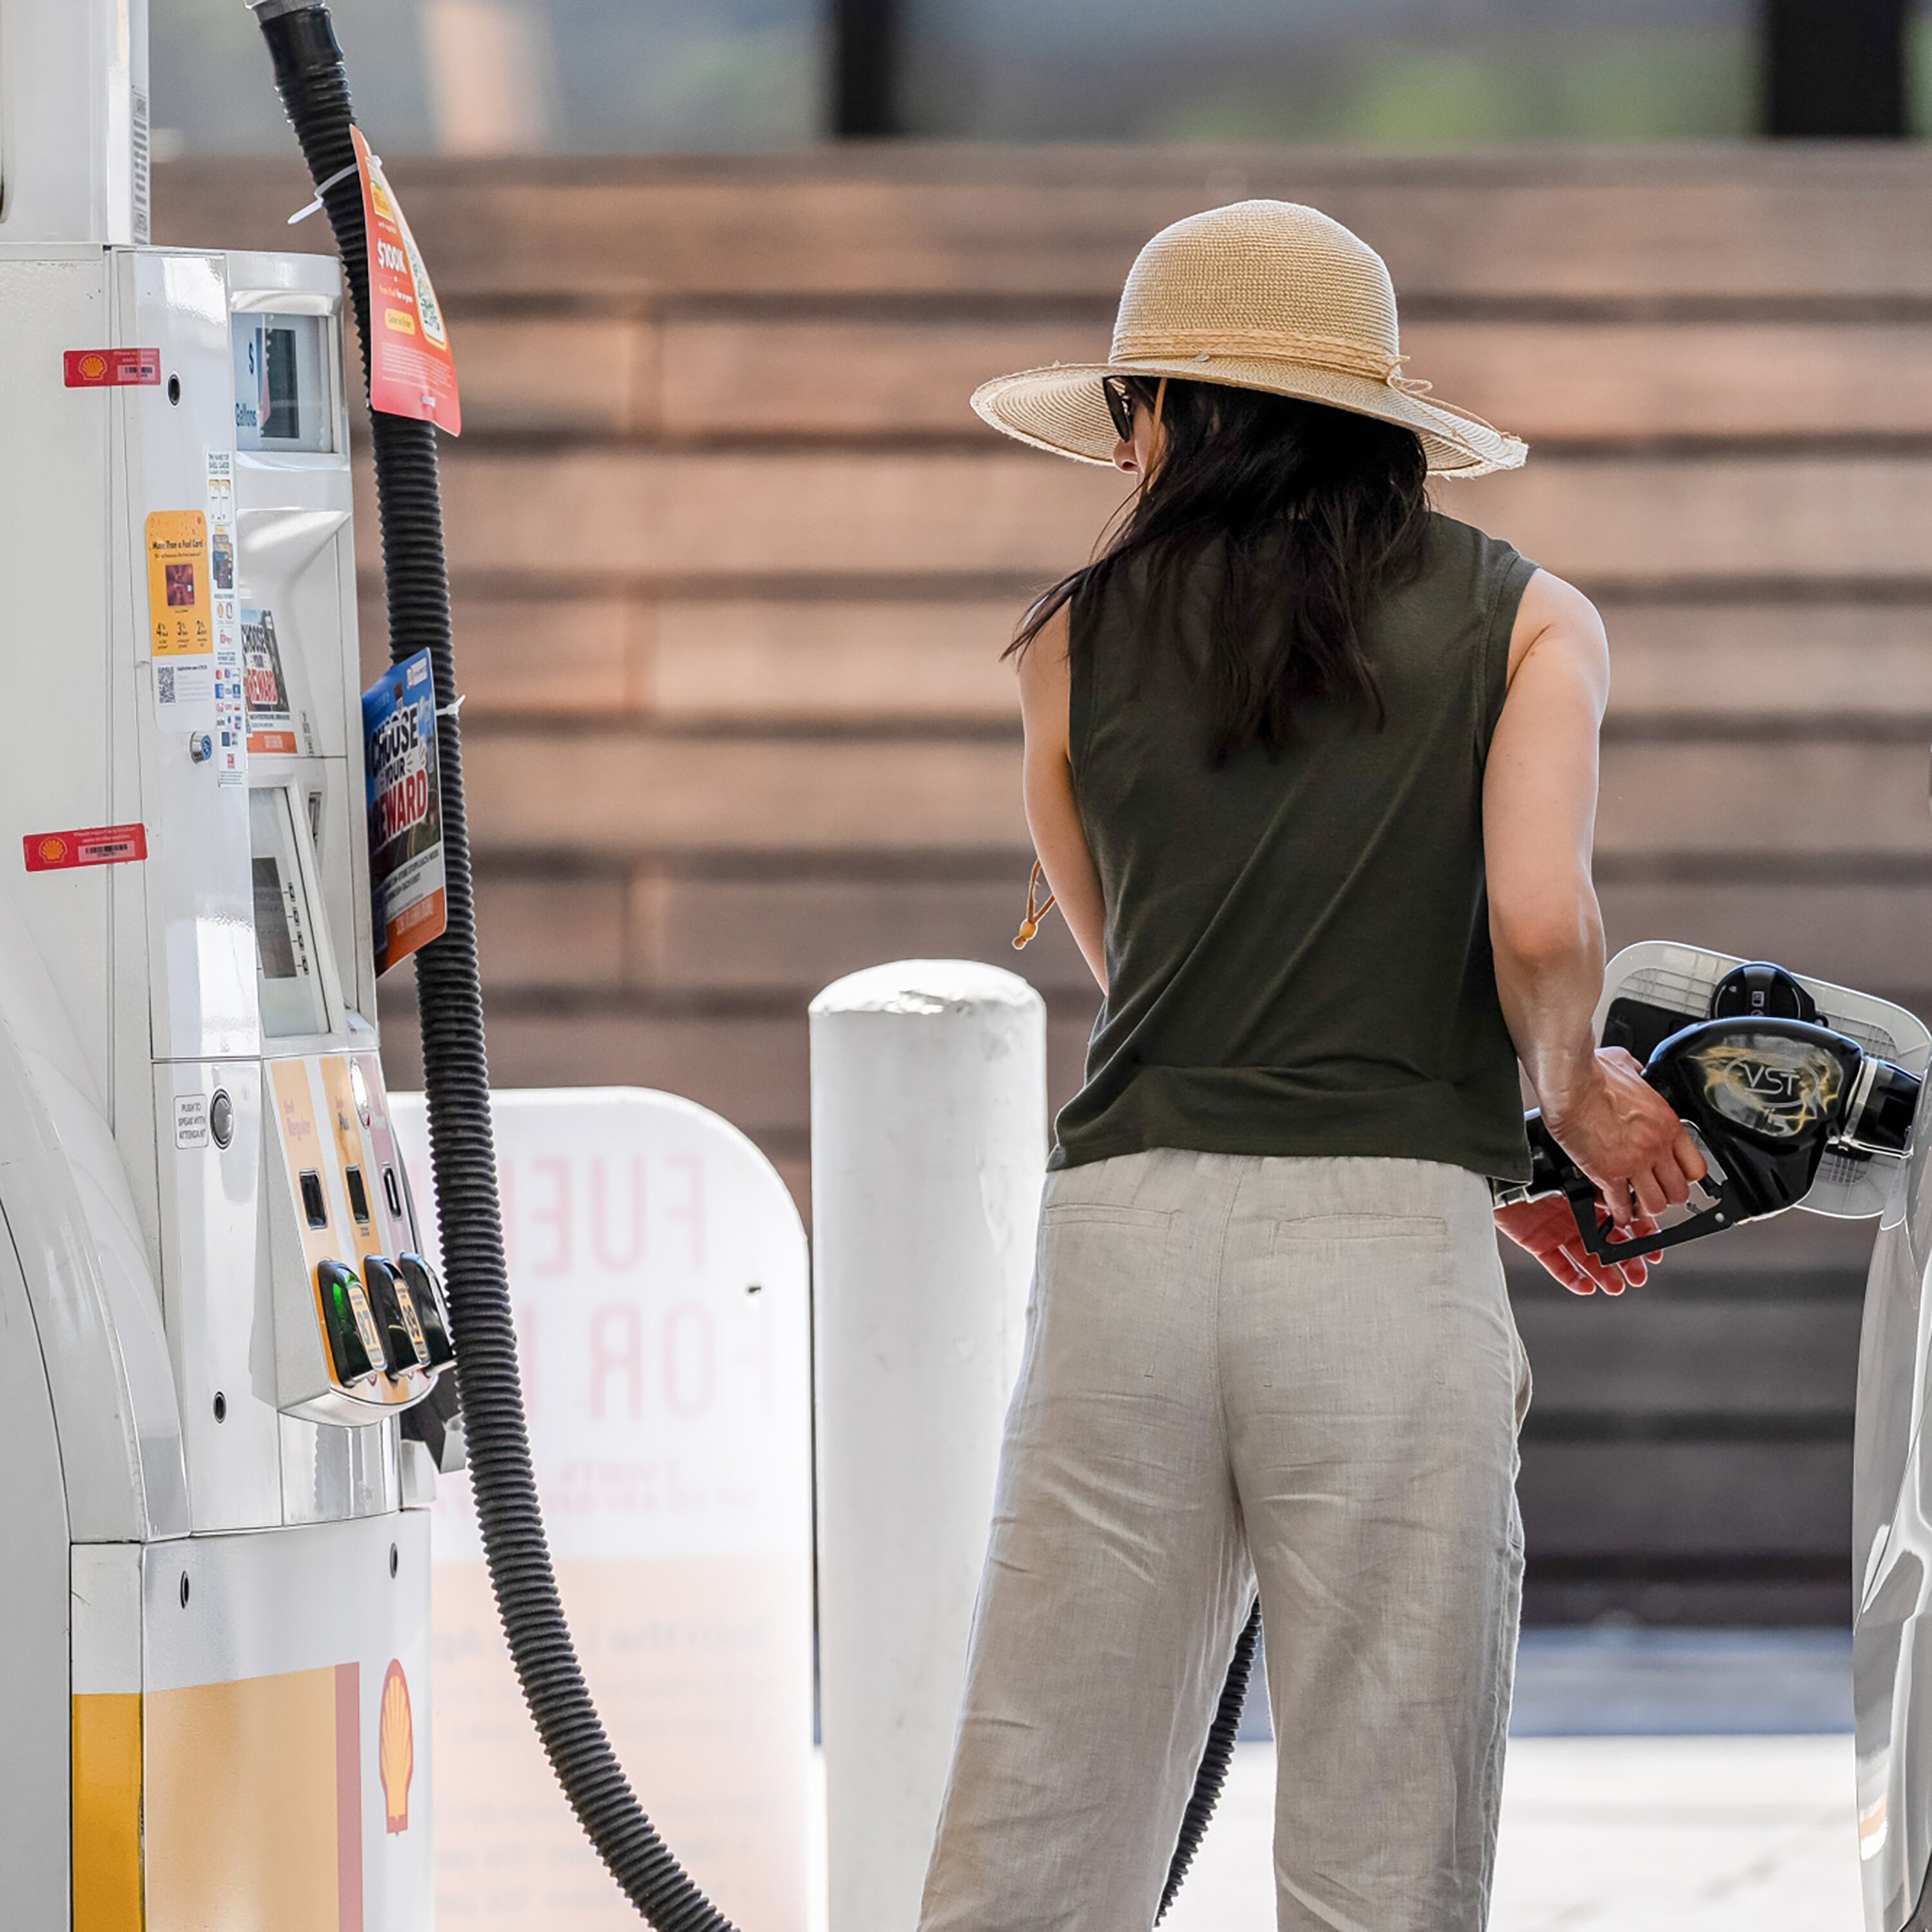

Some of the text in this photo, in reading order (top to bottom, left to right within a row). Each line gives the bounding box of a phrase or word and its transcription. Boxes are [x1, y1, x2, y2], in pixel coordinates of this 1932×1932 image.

[372, 707, 419, 777] CHOOSE
[1740, 1063, 1801, 1096] VST
[182, 1102, 202, 1113] PUSH TO
[178, 1115, 206, 1127] SPEAK WITH
[179, 1128, 206, 1139] ATTENDANT
[355, 1309, 377, 1345] 87
